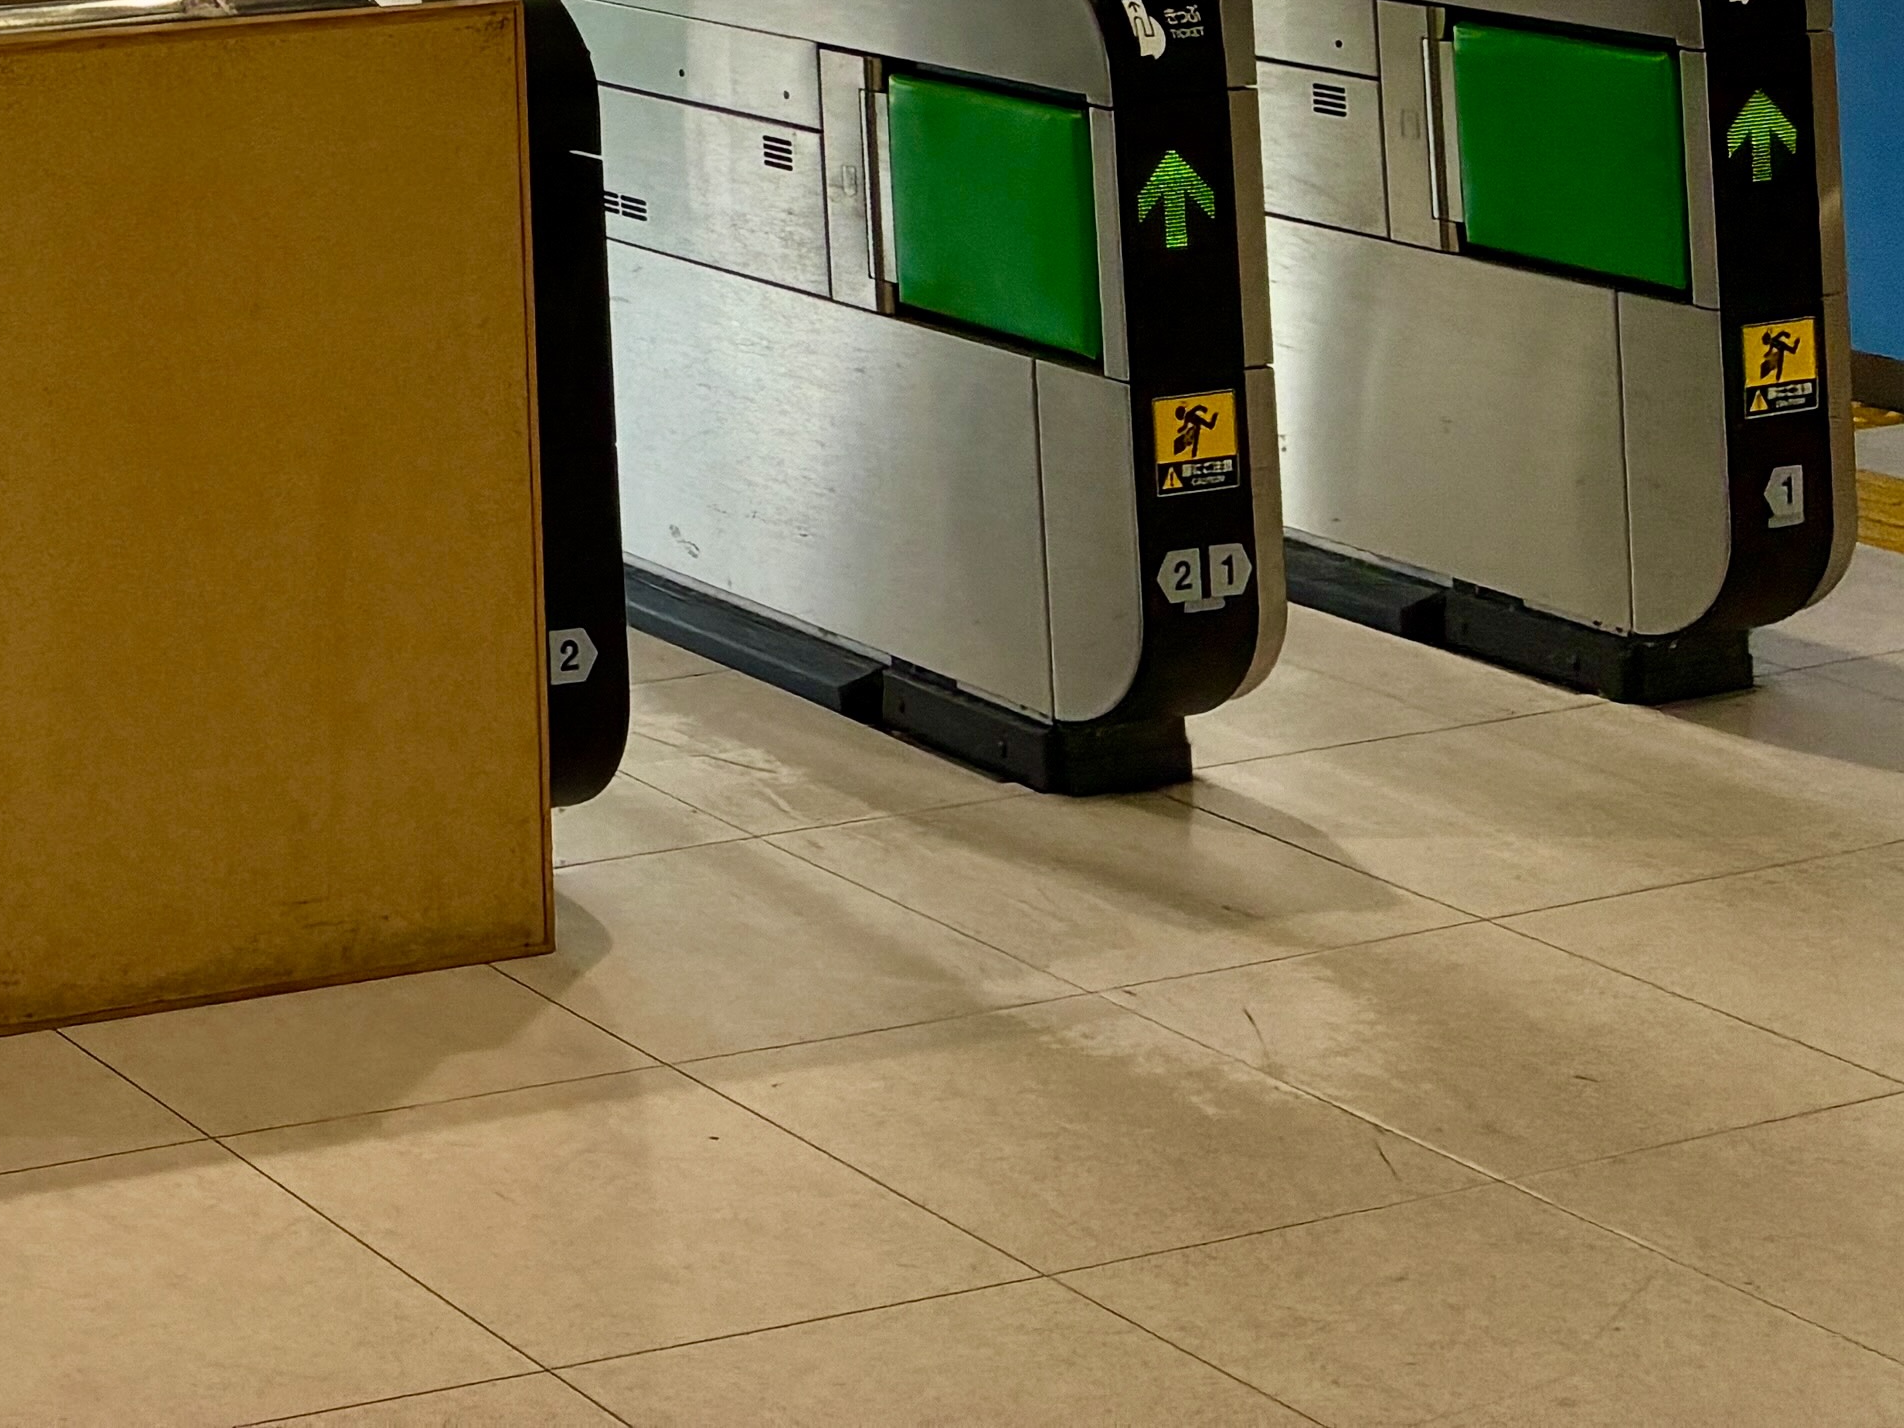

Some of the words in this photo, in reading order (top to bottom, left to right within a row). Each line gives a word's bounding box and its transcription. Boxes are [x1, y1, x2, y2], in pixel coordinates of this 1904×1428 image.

[1781, 475, 1793, 505] 1
[1174, 560, 1193, 591] 2
[1220, 553, 1234, 585] 1
[560, 639, 580, 672] 2
